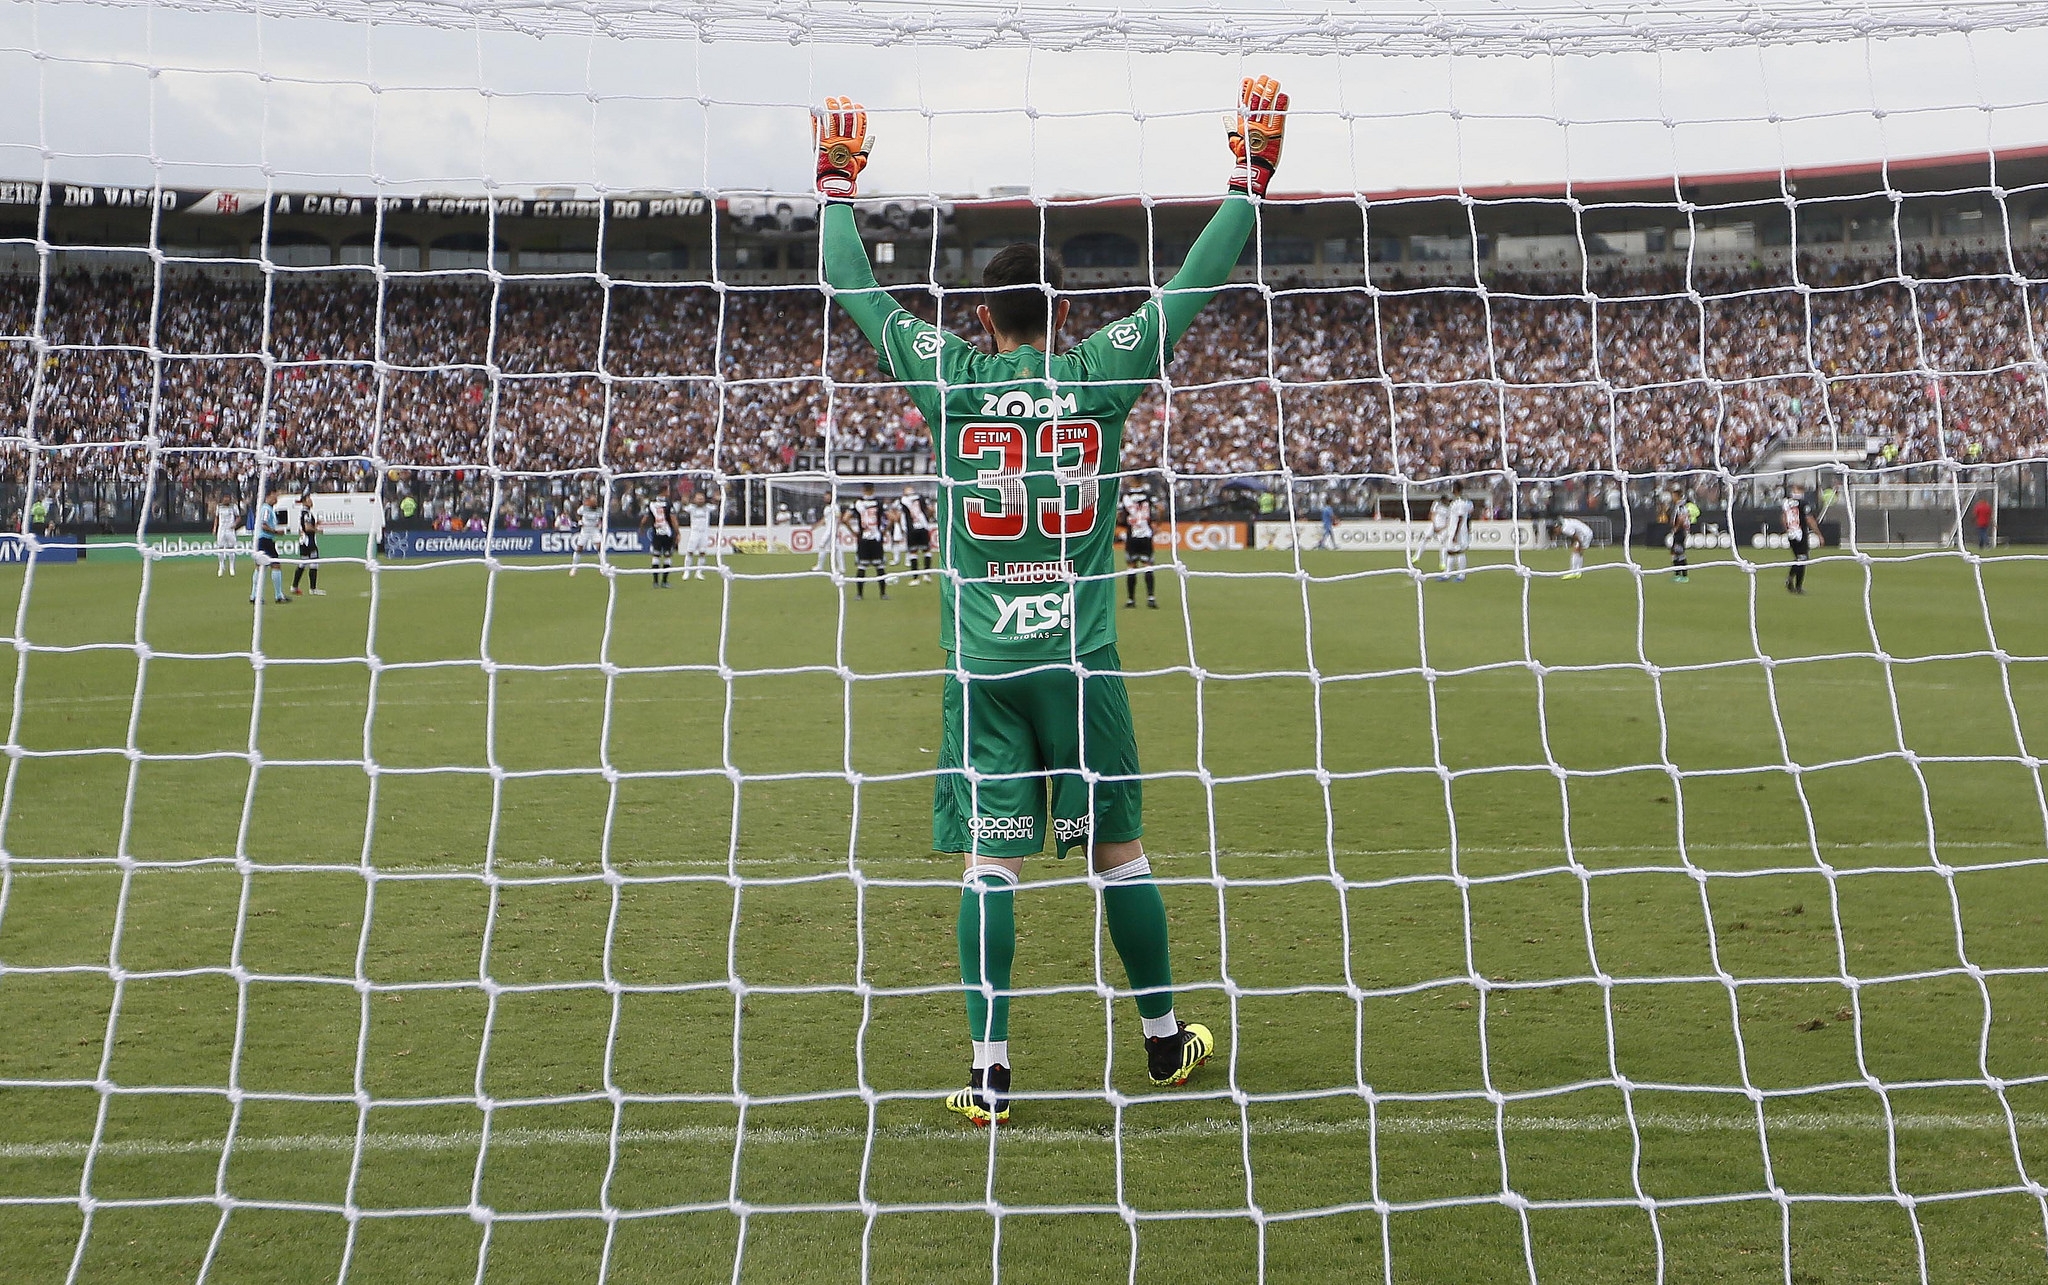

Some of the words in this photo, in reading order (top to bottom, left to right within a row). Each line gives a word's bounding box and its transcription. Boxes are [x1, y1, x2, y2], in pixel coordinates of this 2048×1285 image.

[0, 182, 51, 204] EIR
[64, 185, 94, 206] DO
[276, 194, 291, 215] A
[303, 193, 362, 215] CASA
[613, 200, 641, 218] DO
[649, 198, 704, 217] POVO
[980, 391, 1078, 418] ZOOM
[987, 431, 1011, 442] TIM
[1066, 427, 1088, 440] TIM
[959, 419, 1102, 540] 33
[415, 538, 425, 551] O
[1185, 524, 1244, 551] GOL
[991, 593, 1070, 634] YES!
[967, 815, 1034, 829] ODONTO
[970, 828, 1034, 841] company
